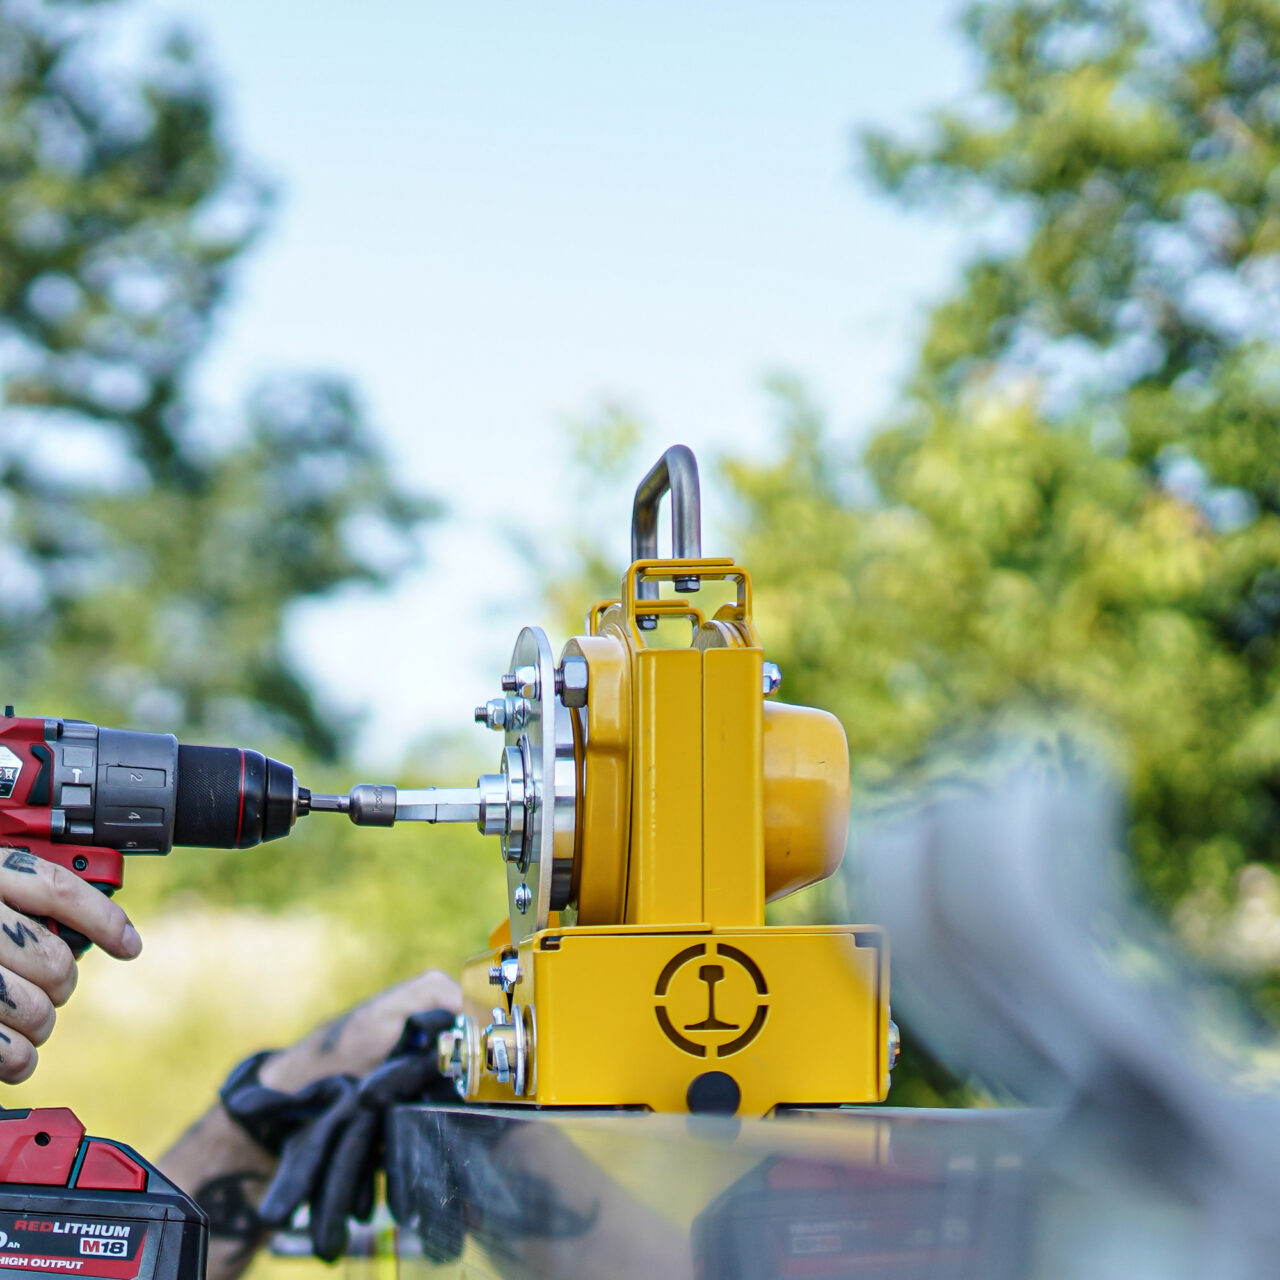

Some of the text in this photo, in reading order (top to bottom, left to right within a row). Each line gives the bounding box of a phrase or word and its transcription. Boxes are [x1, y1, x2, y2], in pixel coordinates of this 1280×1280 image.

[130, 773, 144, 782] 2
[128, 811, 141, 820] 4
[14, 1219, 130, 1238] REDLITHIUM
[82, 1240, 125, 1255] M18
[30, 1258, 84, 1270] OUTPUT
